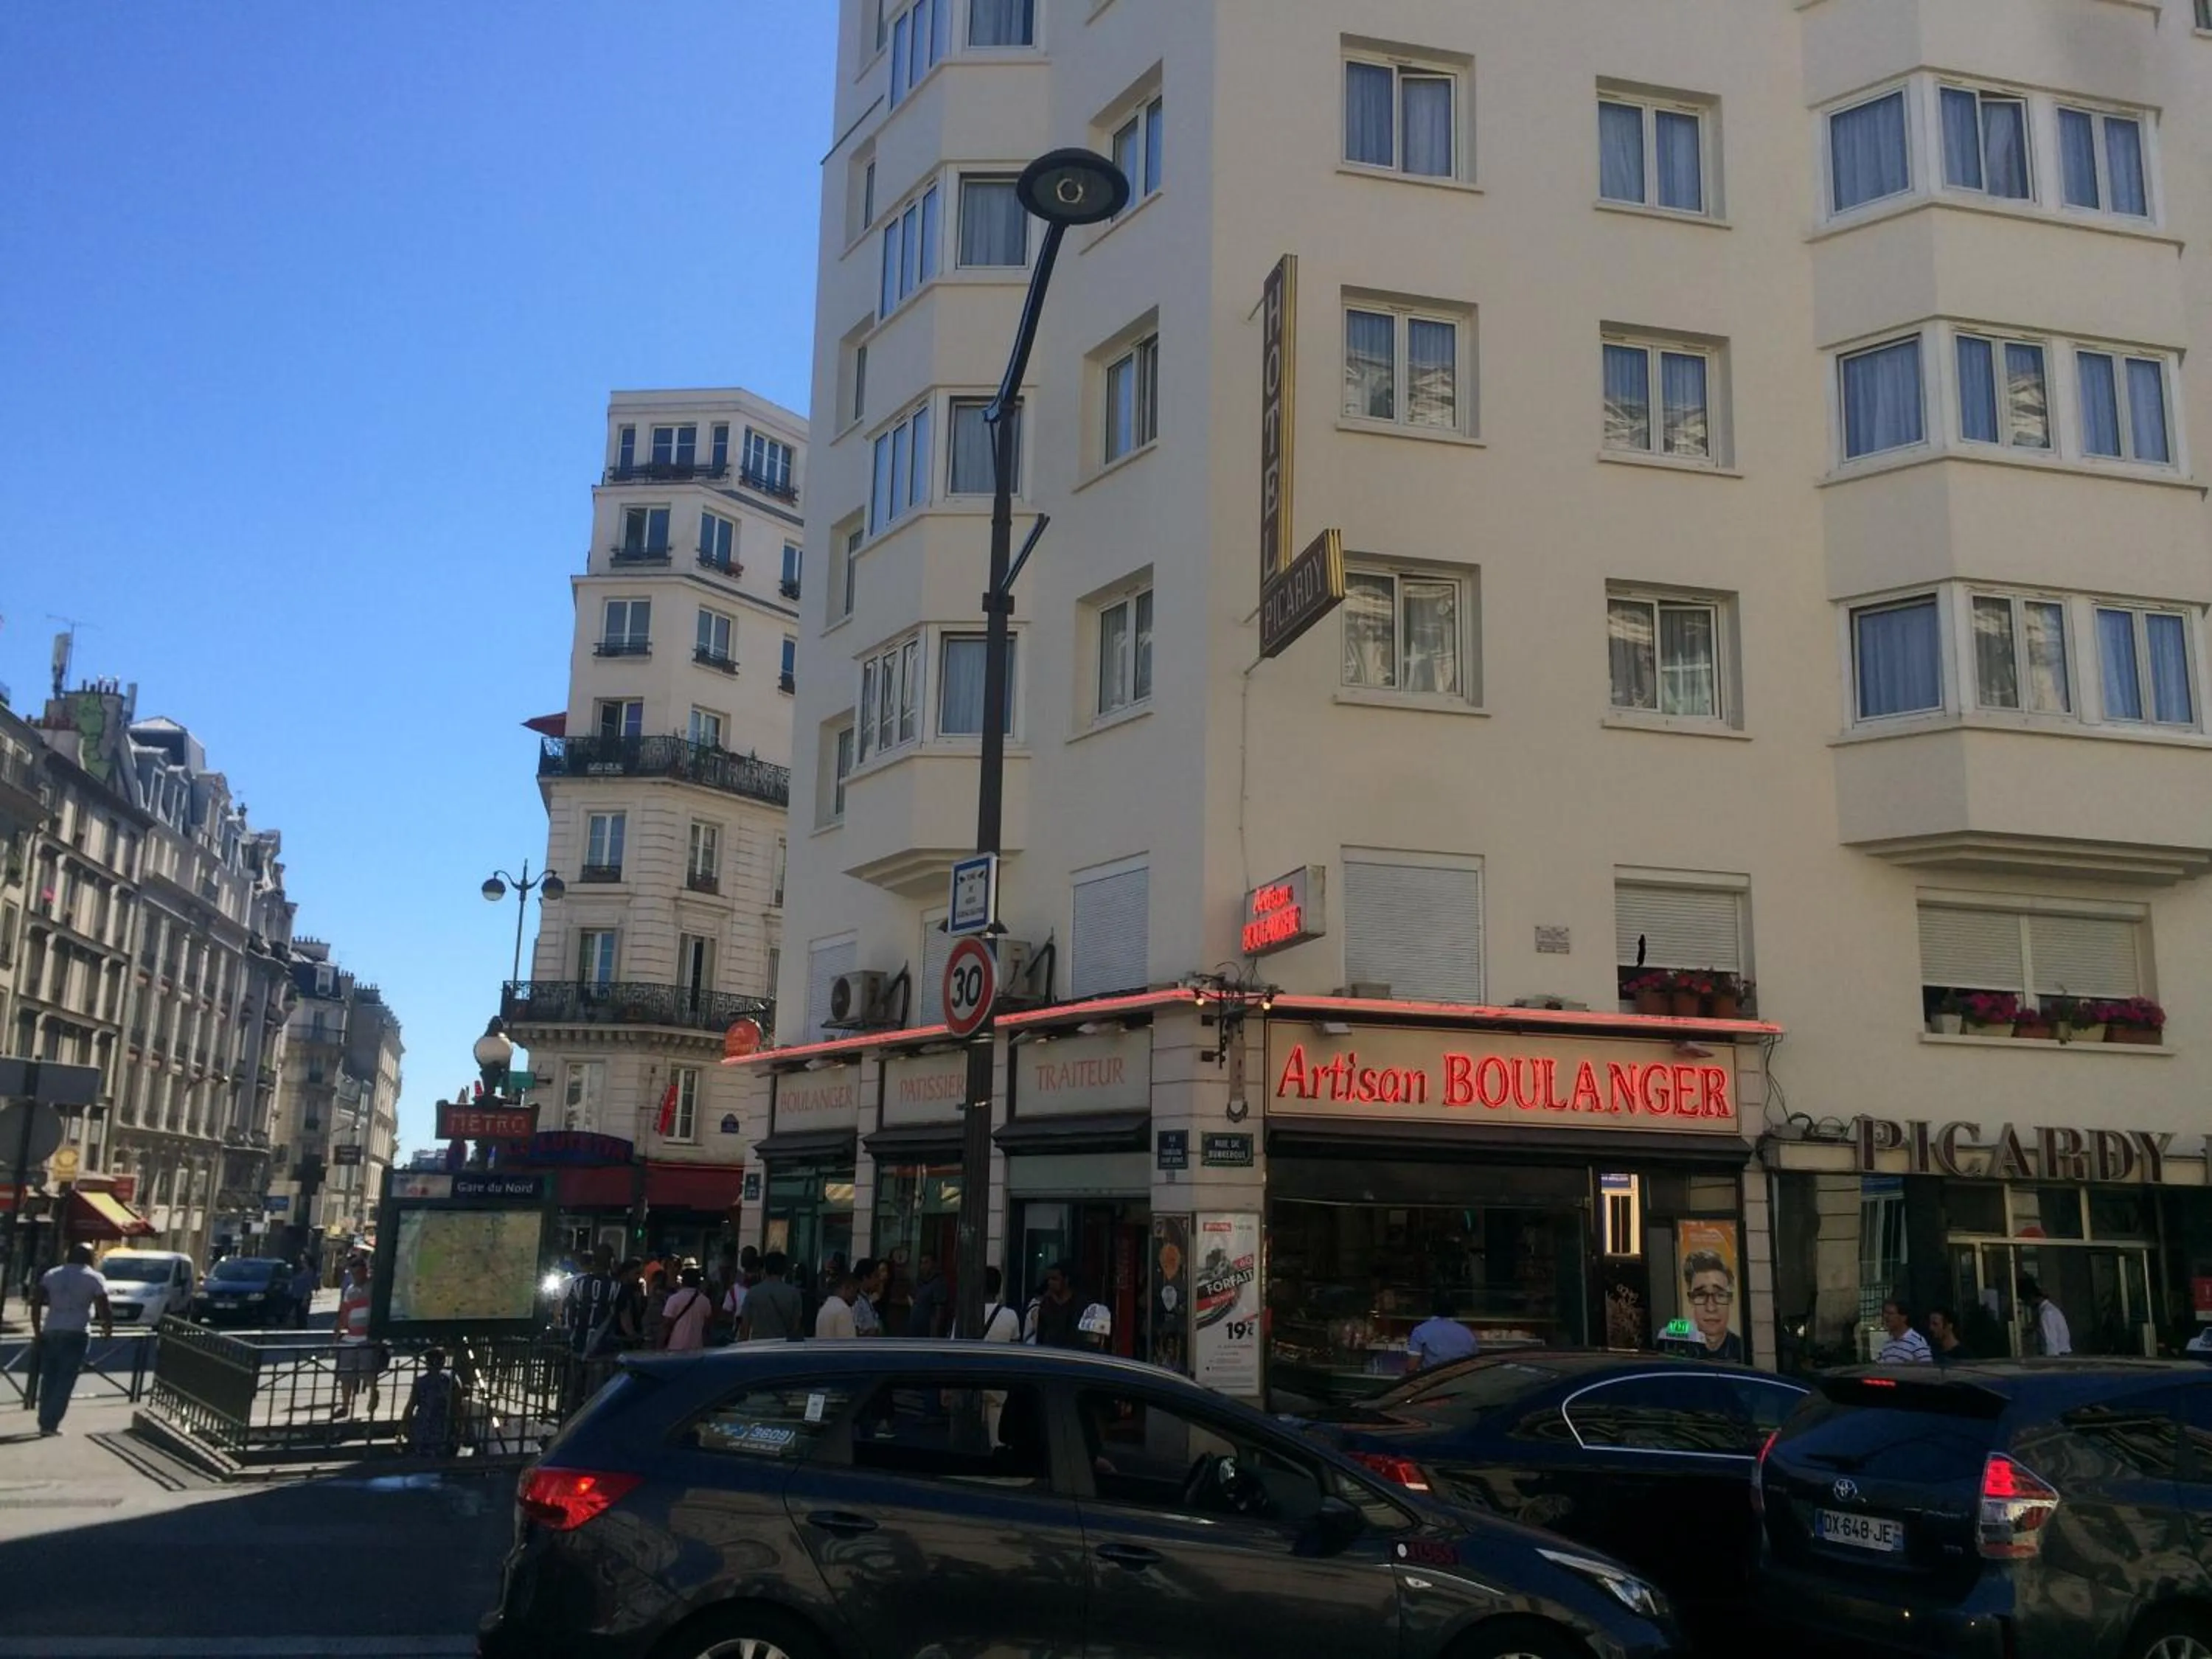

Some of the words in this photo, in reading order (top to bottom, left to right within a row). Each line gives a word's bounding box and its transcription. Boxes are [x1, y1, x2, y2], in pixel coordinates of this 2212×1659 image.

[1264, 280, 1281, 584] HOTEL
[1264, 549, 1323, 639] PICARDY
[951, 964, 983, 1008] 30
[899, 1073, 965, 1107] PATISSIER
[1034, 1057, 1125, 1091] TRAITEUR
[1276, 1043, 1428, 1104] Artisan
[1442, 1052, 1735, 1119] BOULANGER
[779, 1083, 853, 1114] BOULANGER
[1851, 1113, 2177, 1182] PICARDY
[456, 1181, 485, 1193] Gare
[487, 1181, 503, 1193] du
[505, 1181, 534, 1193] Nord
[1206, 1270, 1254, 1295] FORFAIT
